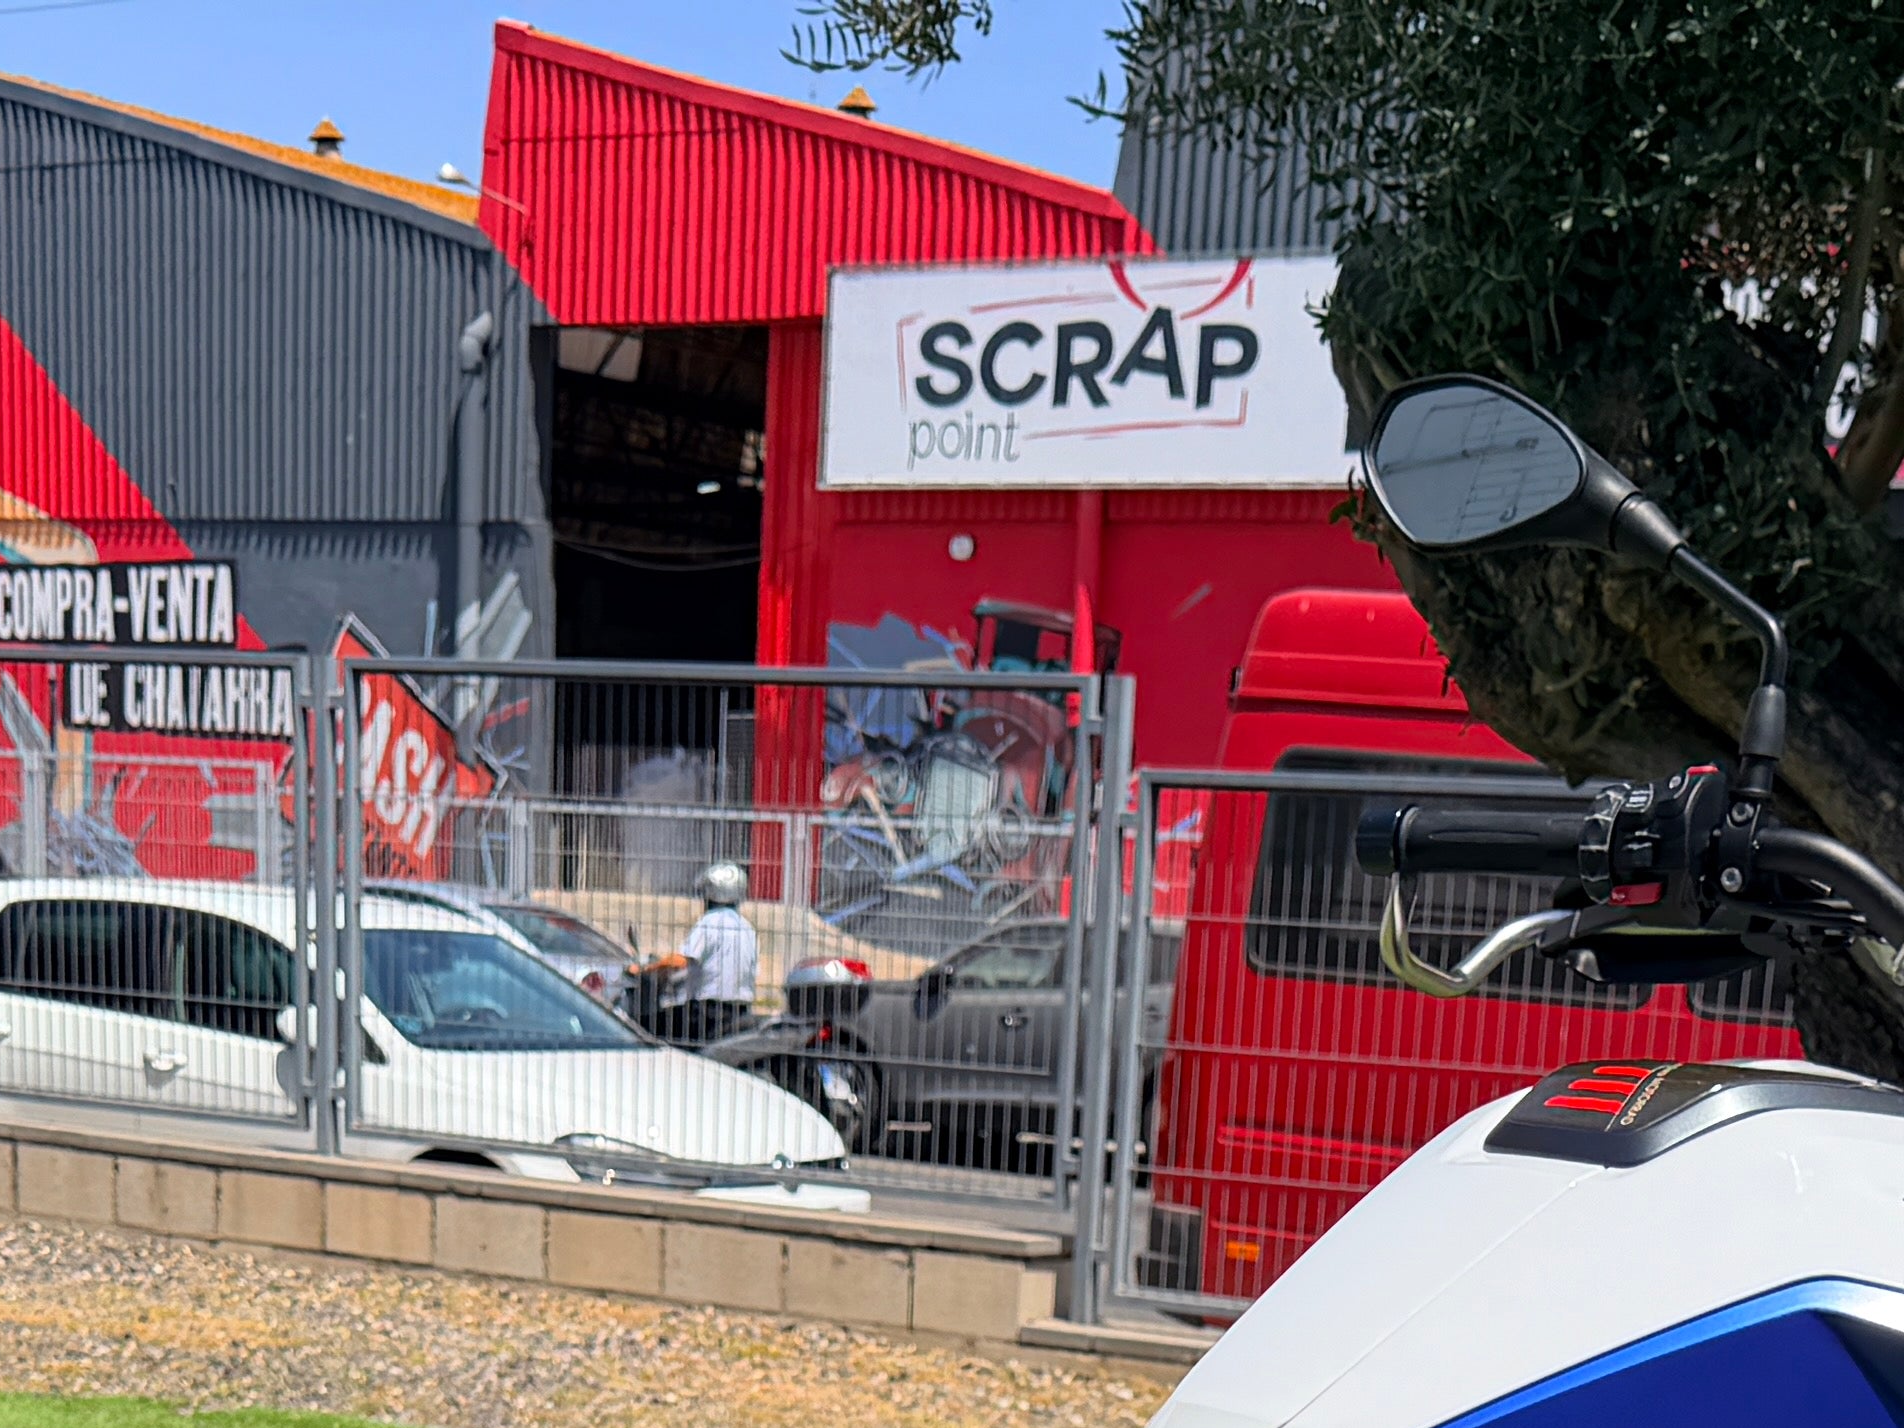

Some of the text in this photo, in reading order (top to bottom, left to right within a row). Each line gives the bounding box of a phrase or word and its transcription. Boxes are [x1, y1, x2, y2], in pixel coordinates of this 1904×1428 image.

[915, 307, 1260, 410] SCRAP
[908, 410, 1021, 469] point
[70, 662, 111, 727] DE
